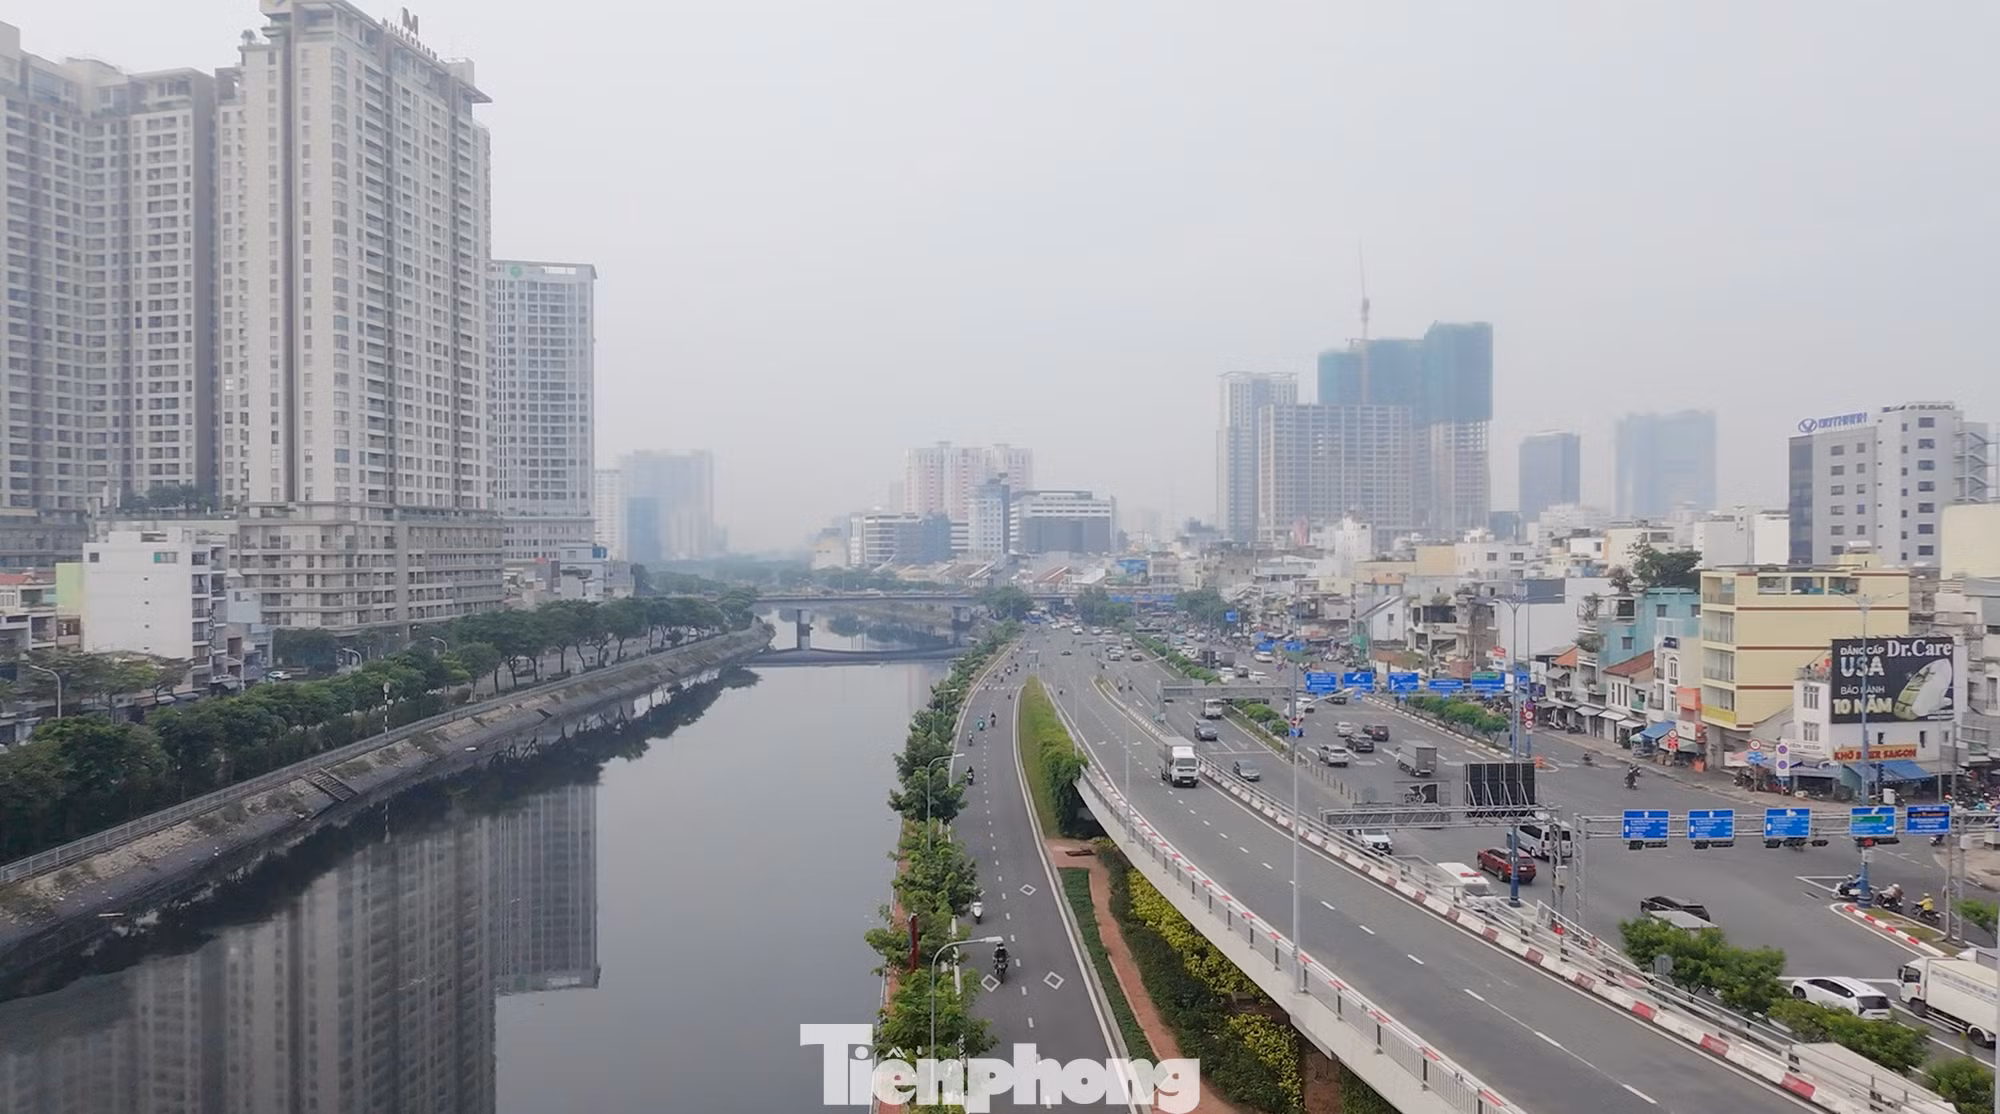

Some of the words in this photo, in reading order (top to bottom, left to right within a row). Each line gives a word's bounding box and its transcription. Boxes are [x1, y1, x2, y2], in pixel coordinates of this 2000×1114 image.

[1866, 644, 1885, 655] CẤP
[1887, 639, 1952, 657] Dr.Care
[1840, 656, 1885, 677] USA
[1833, 699, 1852, 714] 10
[1854, 694, 1892, 714] NĂM
[1884, 748, 1917, 759] SAIGON
